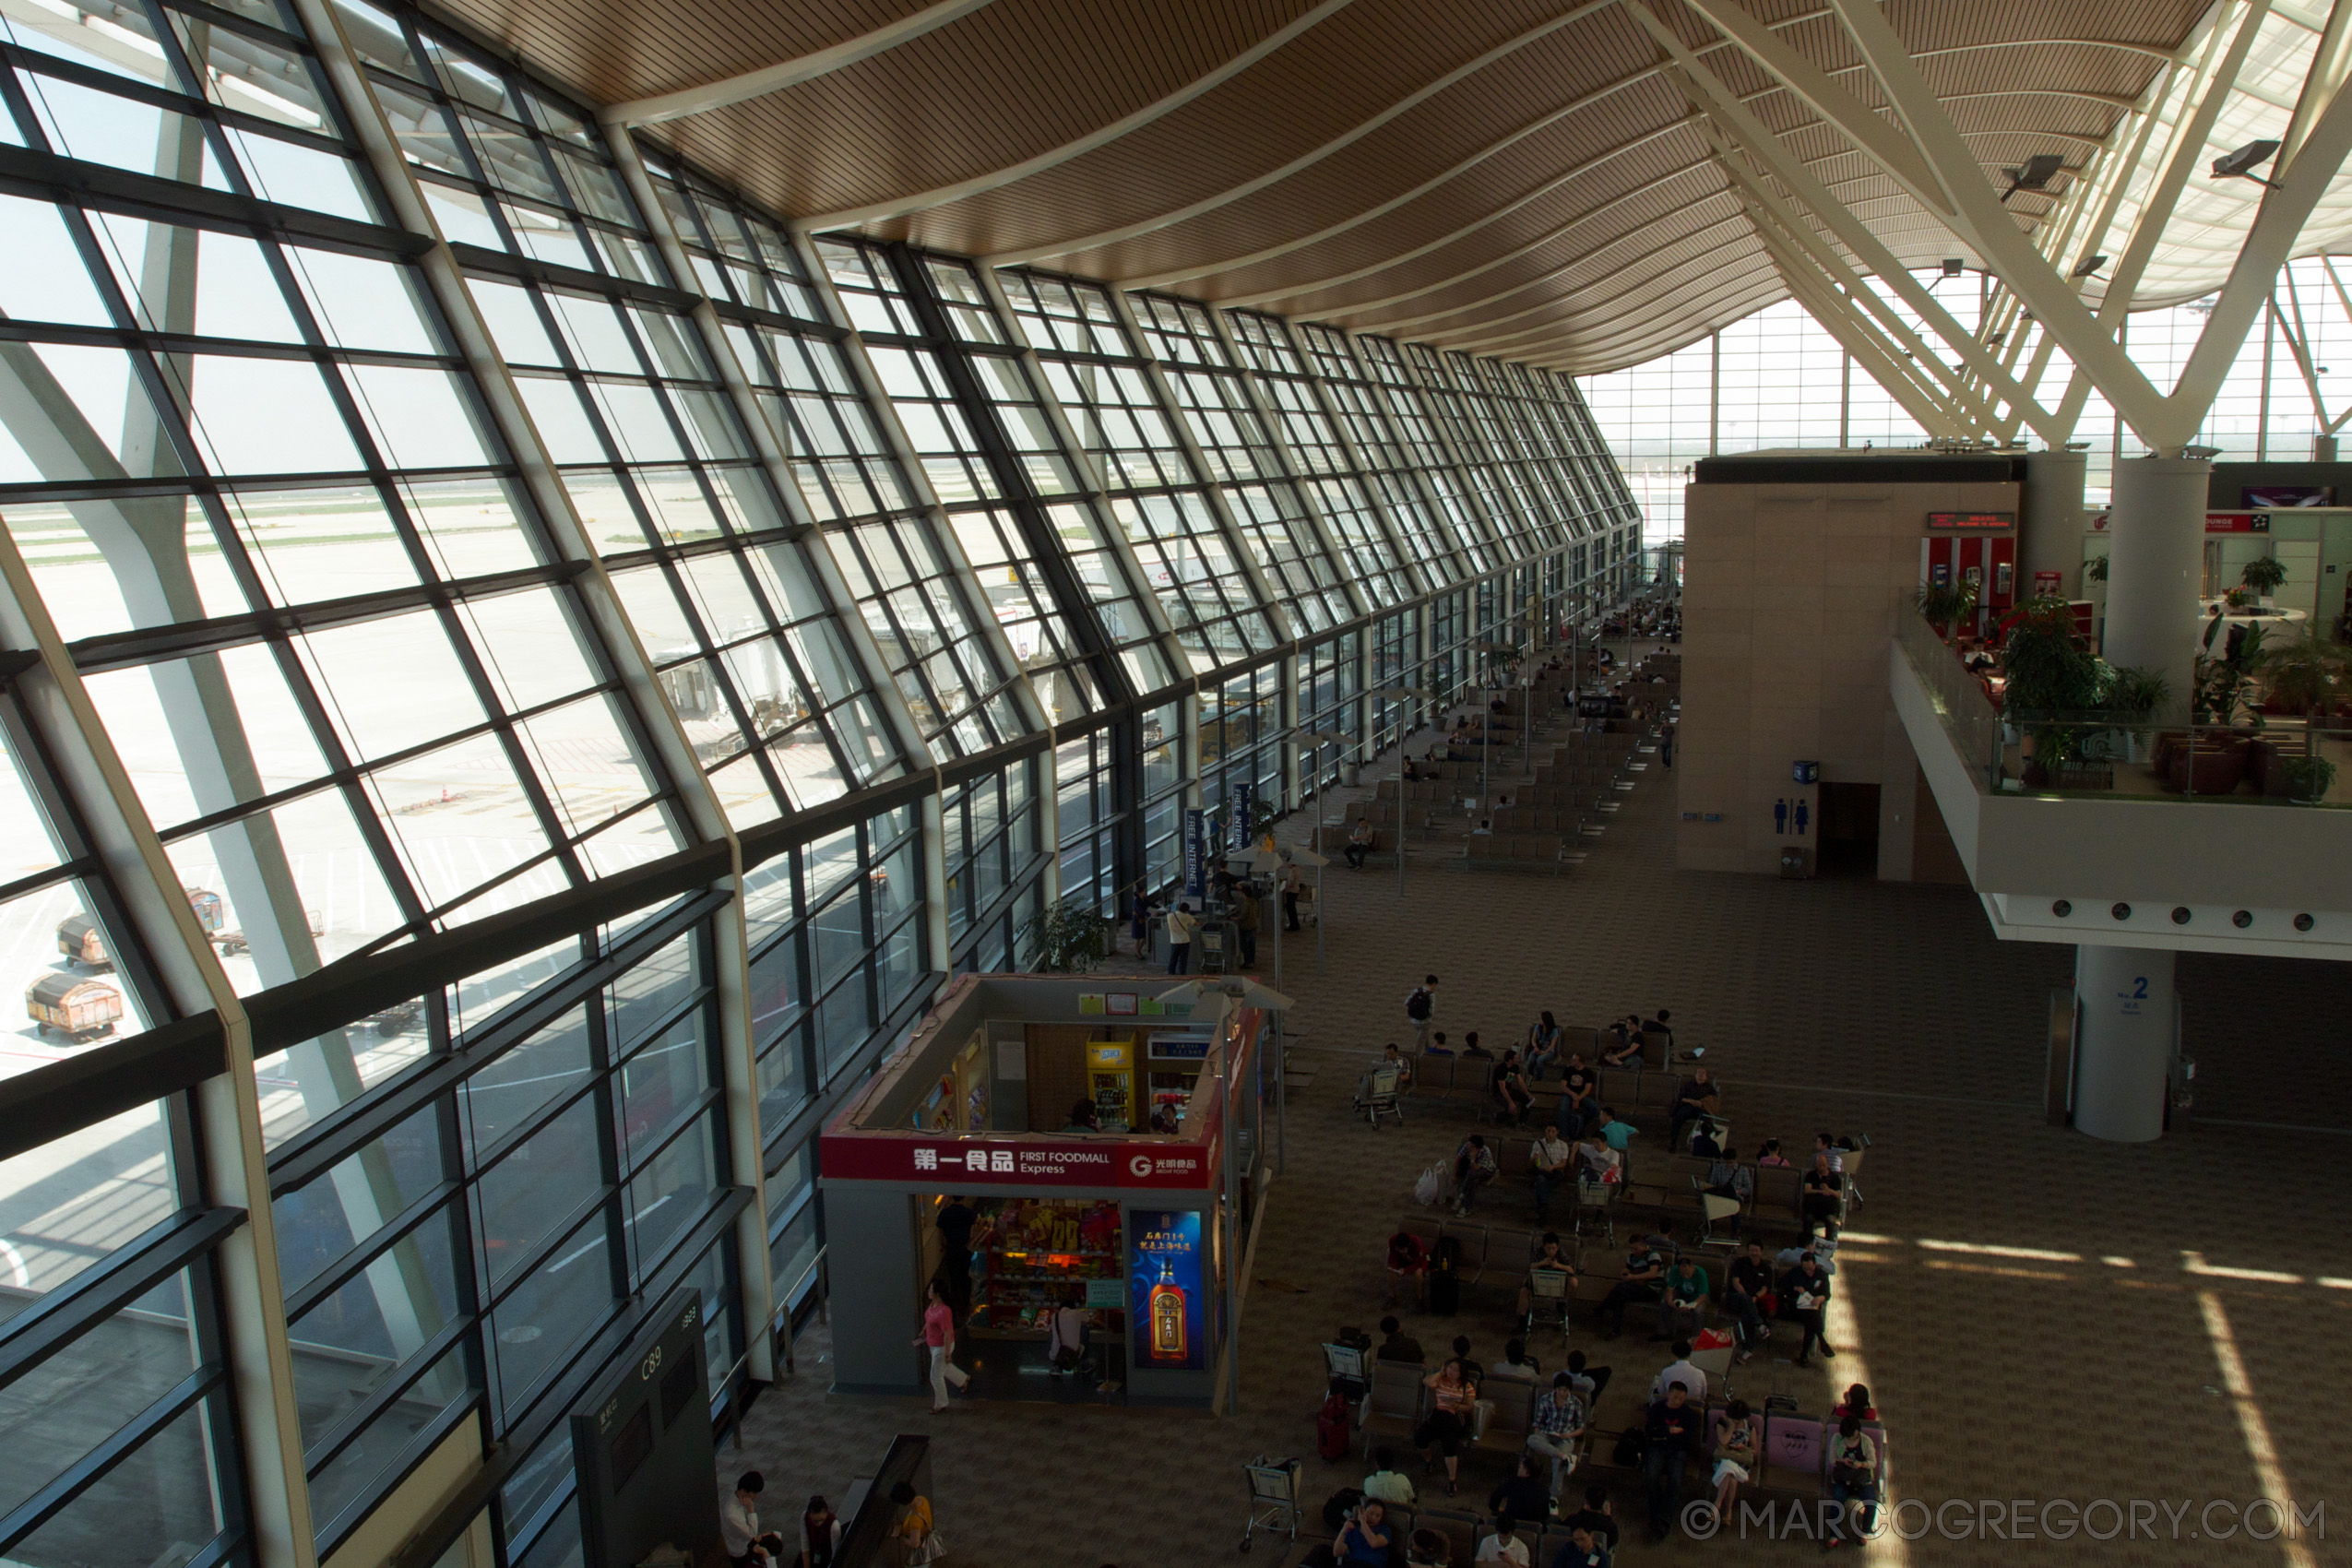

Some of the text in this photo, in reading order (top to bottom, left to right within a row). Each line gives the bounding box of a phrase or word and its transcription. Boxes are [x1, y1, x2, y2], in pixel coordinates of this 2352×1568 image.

[1234, 789, 1242, 854] FREE INTERNE
[1188, 814, 1197, 888] FREE INTERNET
[2133, 977, 2148, 999] 2
[913, 1148, 1015, 1173] 第一食品
[1020, 1151, 1110, 1164] FIRST FOODMALL
[1020, 1163, 1065, 1174] Express
[1155, 1158, 1197, 1170] 光明食品
[641, 1345, 662, 1381] C89
